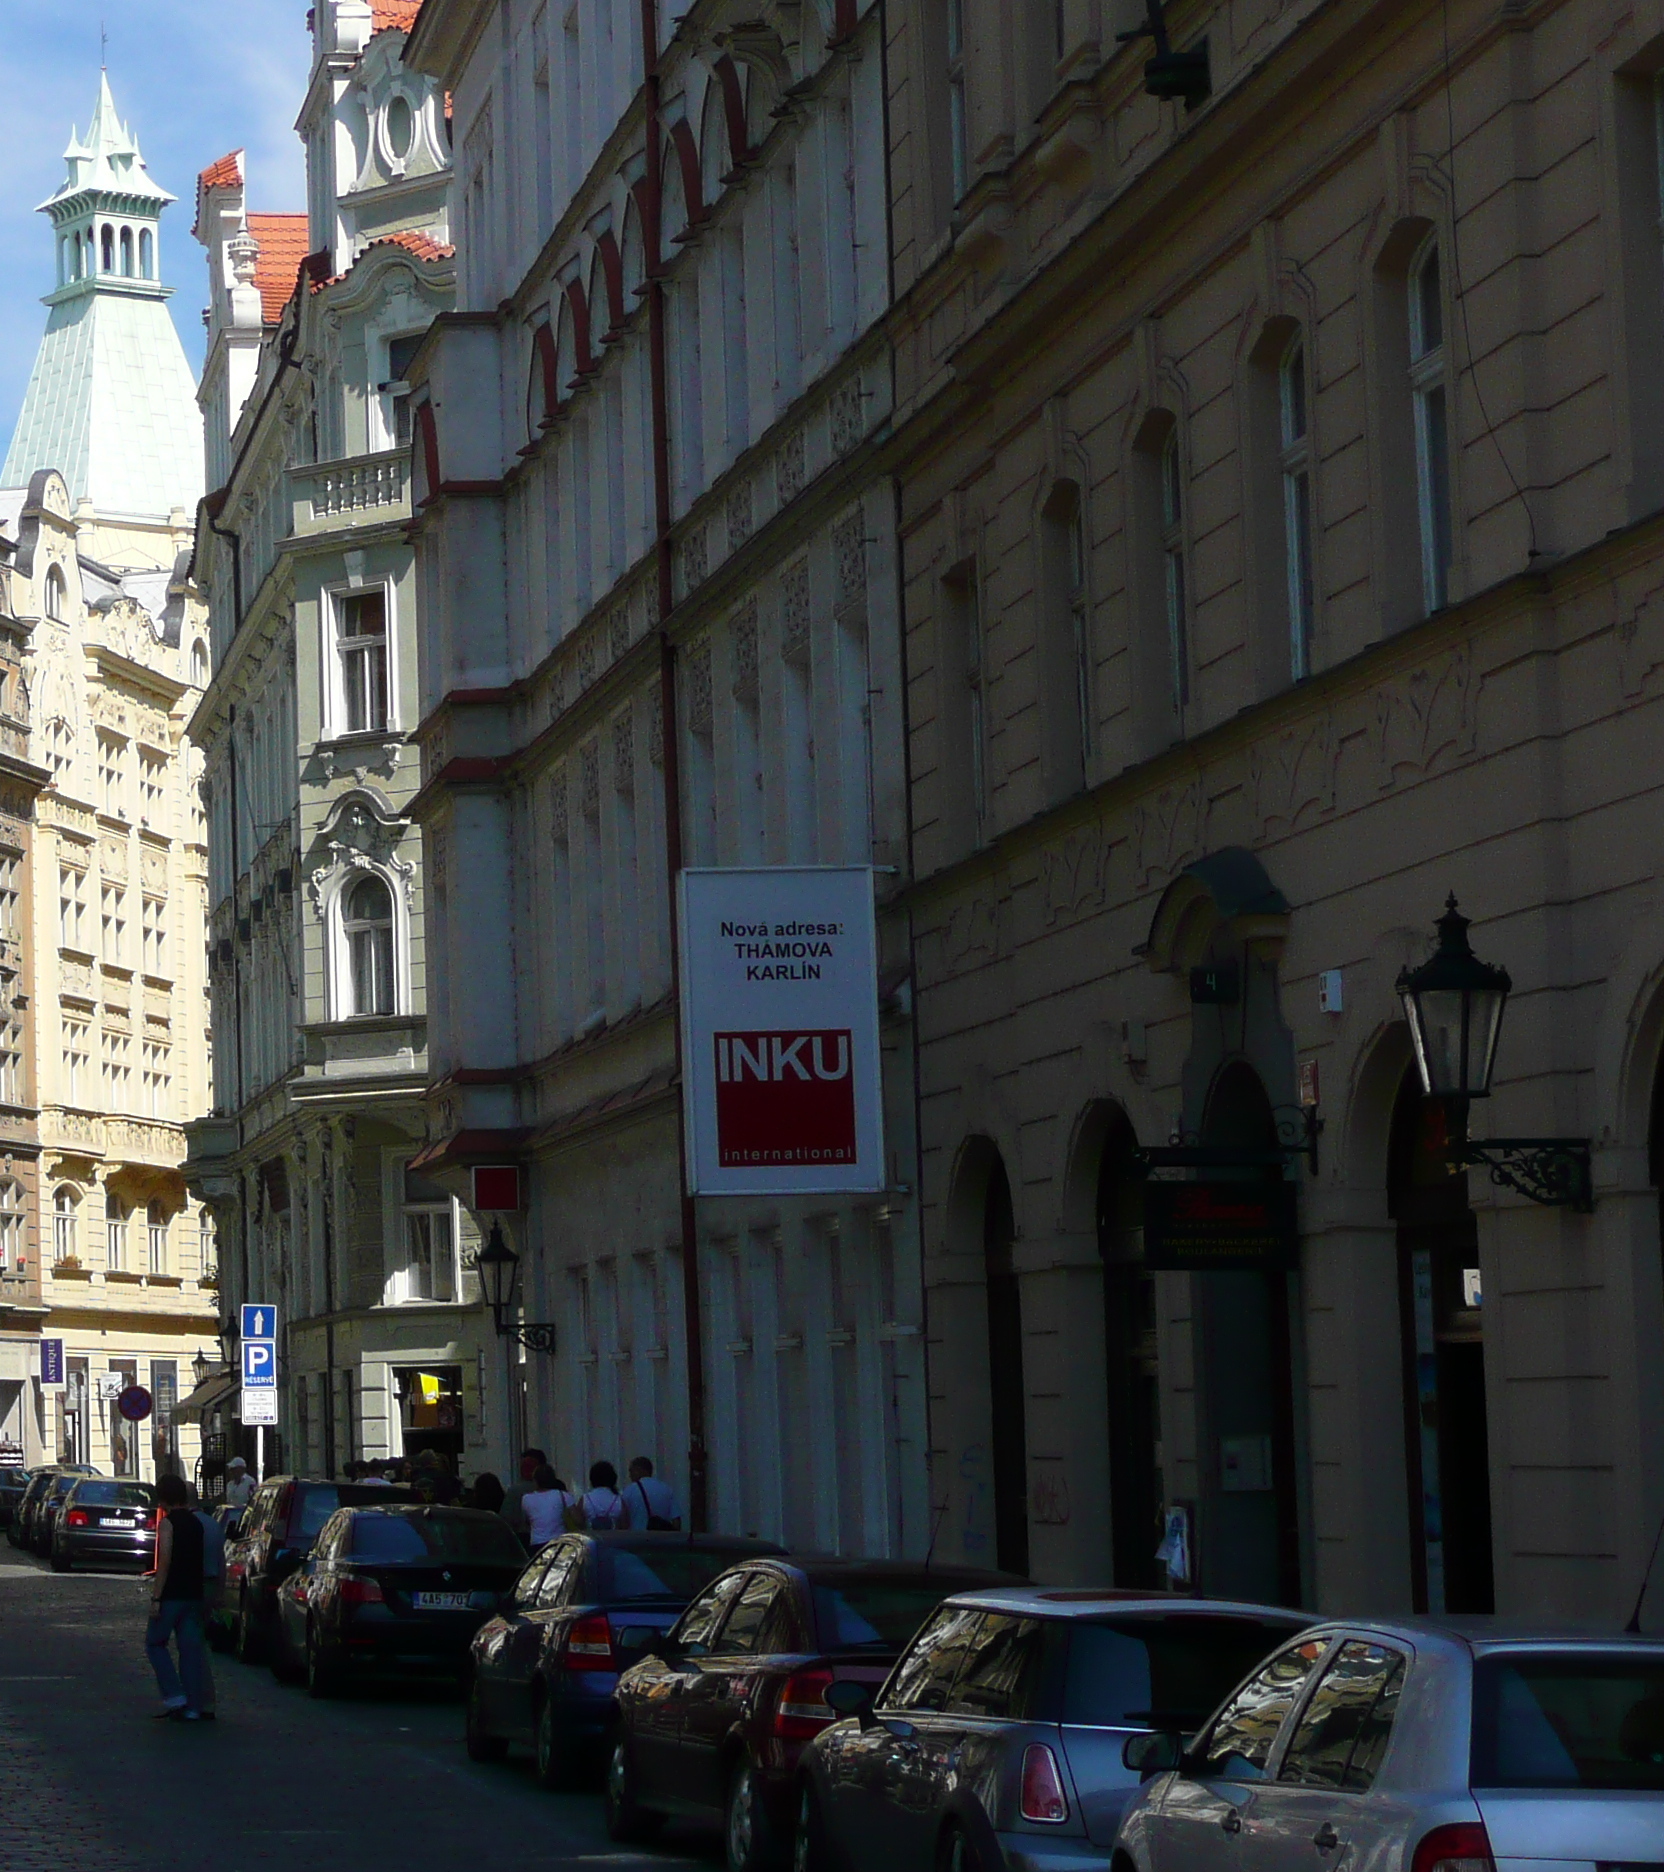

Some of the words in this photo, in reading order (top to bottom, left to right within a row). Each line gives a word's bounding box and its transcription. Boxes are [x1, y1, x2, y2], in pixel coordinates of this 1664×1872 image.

[720, 921, 769, 937] Nová
[774, 921, 844, 937] adresa:
[734, 938, 833, 959] THÁMOVA
[746, 961, 821, 981] KARLÍN
[718, 1035, 850, 1083] INKU
[724, 1146, 852, 1162] international
[48, 1340, 57, 1382] ANTIQUE
[249, 1347, 268, 1374] P
